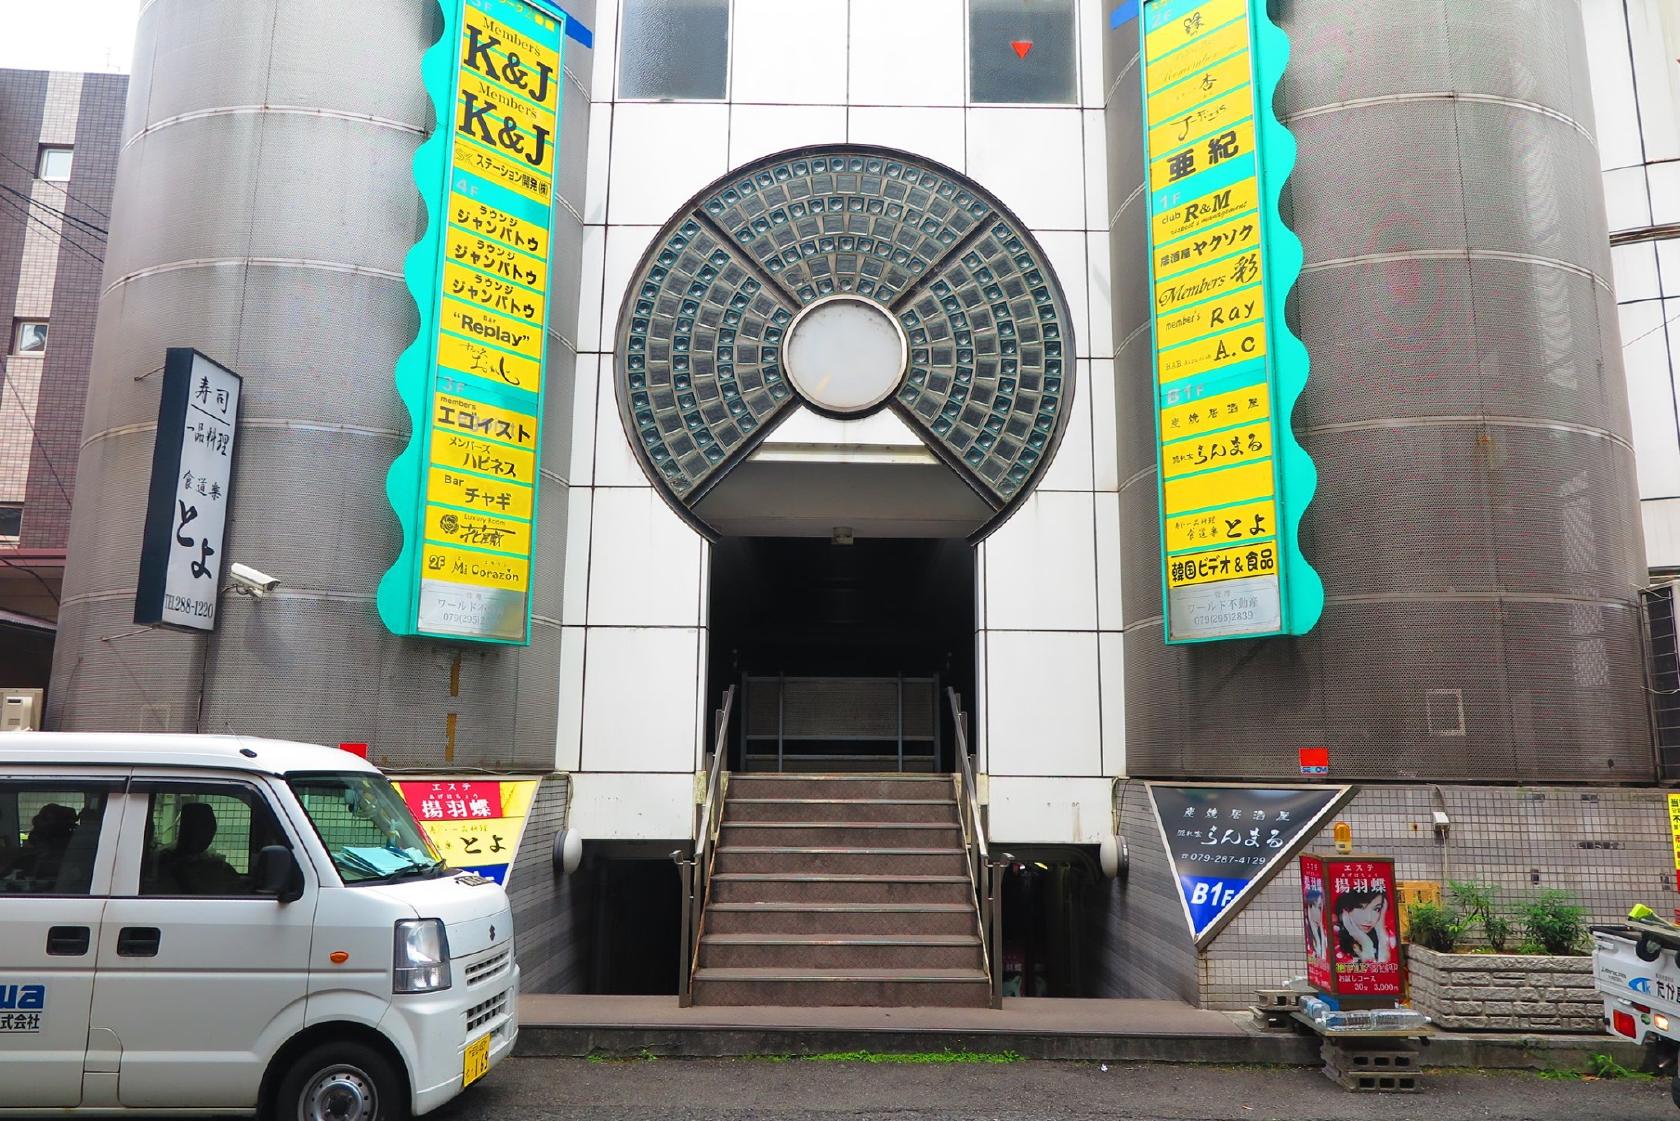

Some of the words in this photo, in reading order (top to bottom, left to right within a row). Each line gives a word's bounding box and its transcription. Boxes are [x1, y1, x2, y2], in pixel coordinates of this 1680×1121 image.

[464, 24, 553, 102] K&J
[459, 90, 550, 166] K&J
[1167, 131, 1239, 182] 亜紀
[1160, 192, 1181, 208] 1F
[1162, 212, 1181, 225] club
[1184, 190, 1231, 223] R&M
[480, 206, 518, 227] ラウンジ
[457, 209, 539, 252] ジャンバトウ
[1193, 224, 1253, 256] ヤクソク
[477, 240, 515, 260] ラウンジ
[454, 244, 537, 285] ジャンバトウ
[474, 275, 513, 295] ラウンジ
[452, 279, 535, 318] ジャンバトウ
[1210, 301, 1255, 328] Ray
[195, 376, 229, 414] 寿司
[438, 405, 531, 442] エゴイスト
[187, 423, 230, 456] 一品料理
[1194, 433, 1263, 465] らんまる
[444, 475, 464, 487] Bar
[465, 488, 511, 510] チャギ
[1225, 514, 1266, 538] とよ
[177, 499, 214, 579] とよ
[429, 555, 446, 570] 2F
[432, 783, 471, 791] エステ
[422, 799, 492, 818] 揚羽蝶
[460, 835, 506, 853] とよ
[1200, 825, 1284, 848] らんまる
[1190, 853, 1266, 865] 079-287-4129
[1191, 881, 1234, 906] B1F
[1335, 877, 1387, 893] 揚羽蝶
